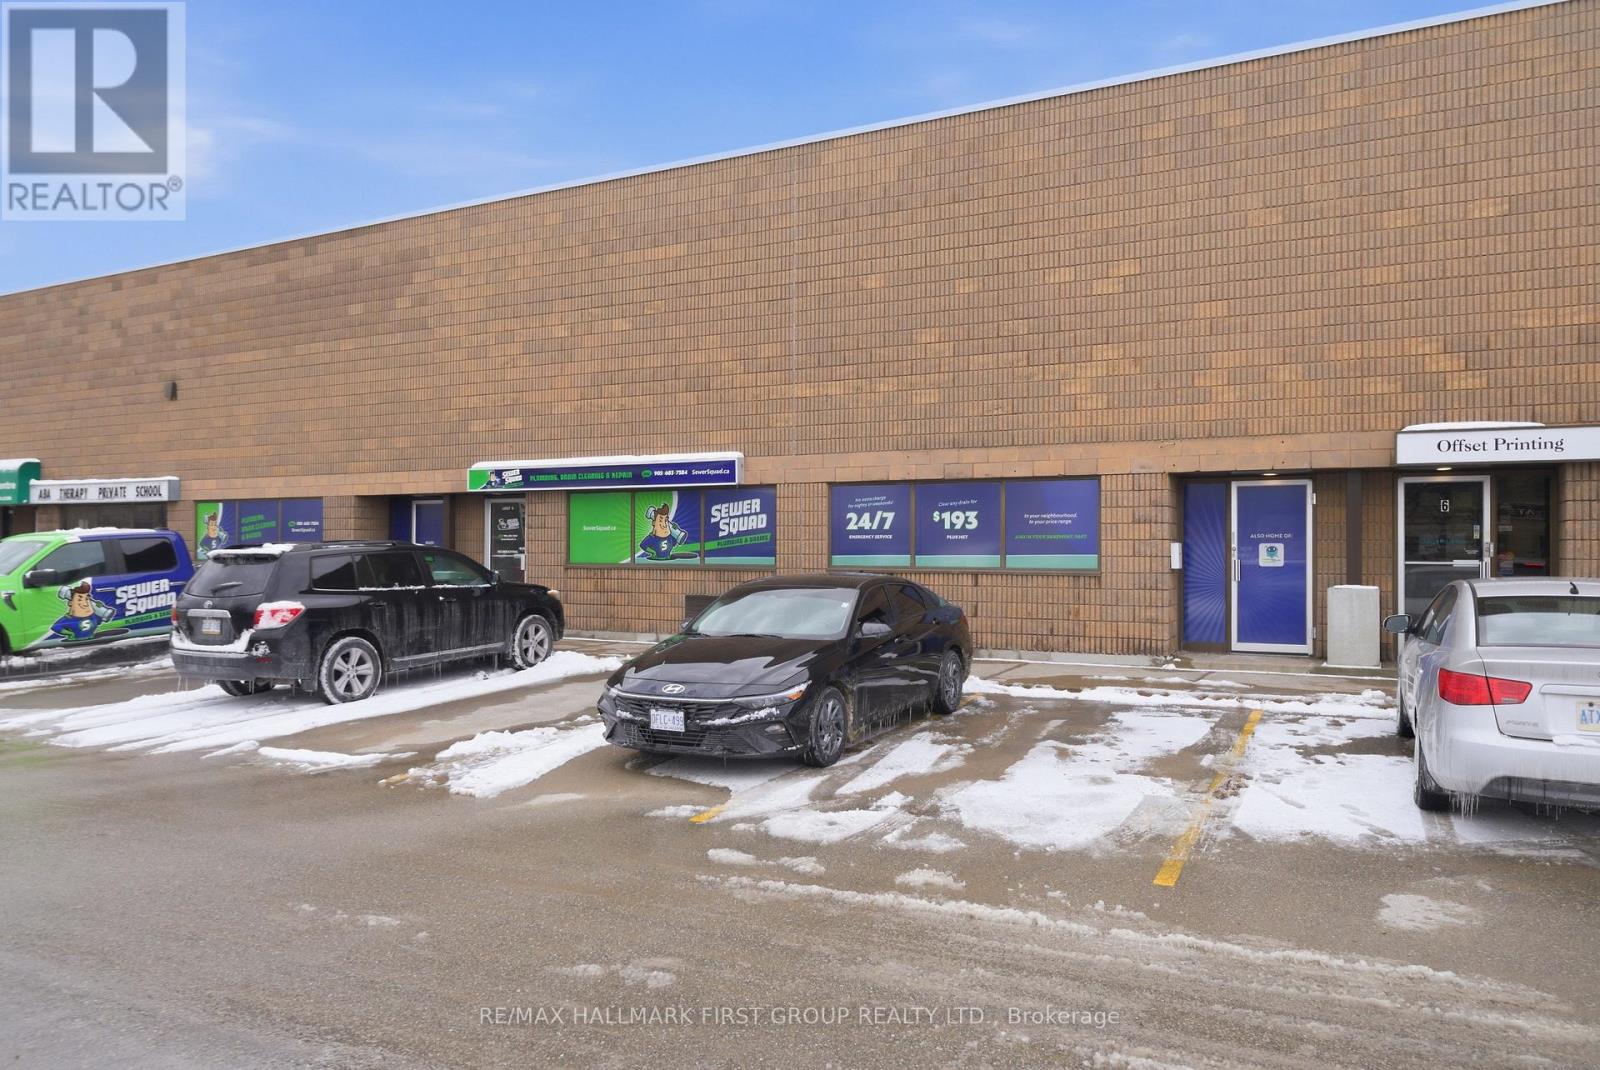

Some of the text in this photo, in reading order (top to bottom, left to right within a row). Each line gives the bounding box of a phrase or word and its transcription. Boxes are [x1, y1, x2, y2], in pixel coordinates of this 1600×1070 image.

[1437, 437, 1565, 452] Offset Printing
[692, 468, 730, 476] SewerSquad.ca
[38, 485, 162, 500] ABA THERAPY PRIVATE SCHOOL
[711, 498, 760, 523] SEWER
[1441, 500, 1449, 512] 6
[718, 513, 768, 537] SQUAD
[846, 510, 896, 530] 24/7
[932, 511, 979, 530] $193
[116, 578, 170, 605] SEWER
[125, 591, 176, 616] SQUAD
